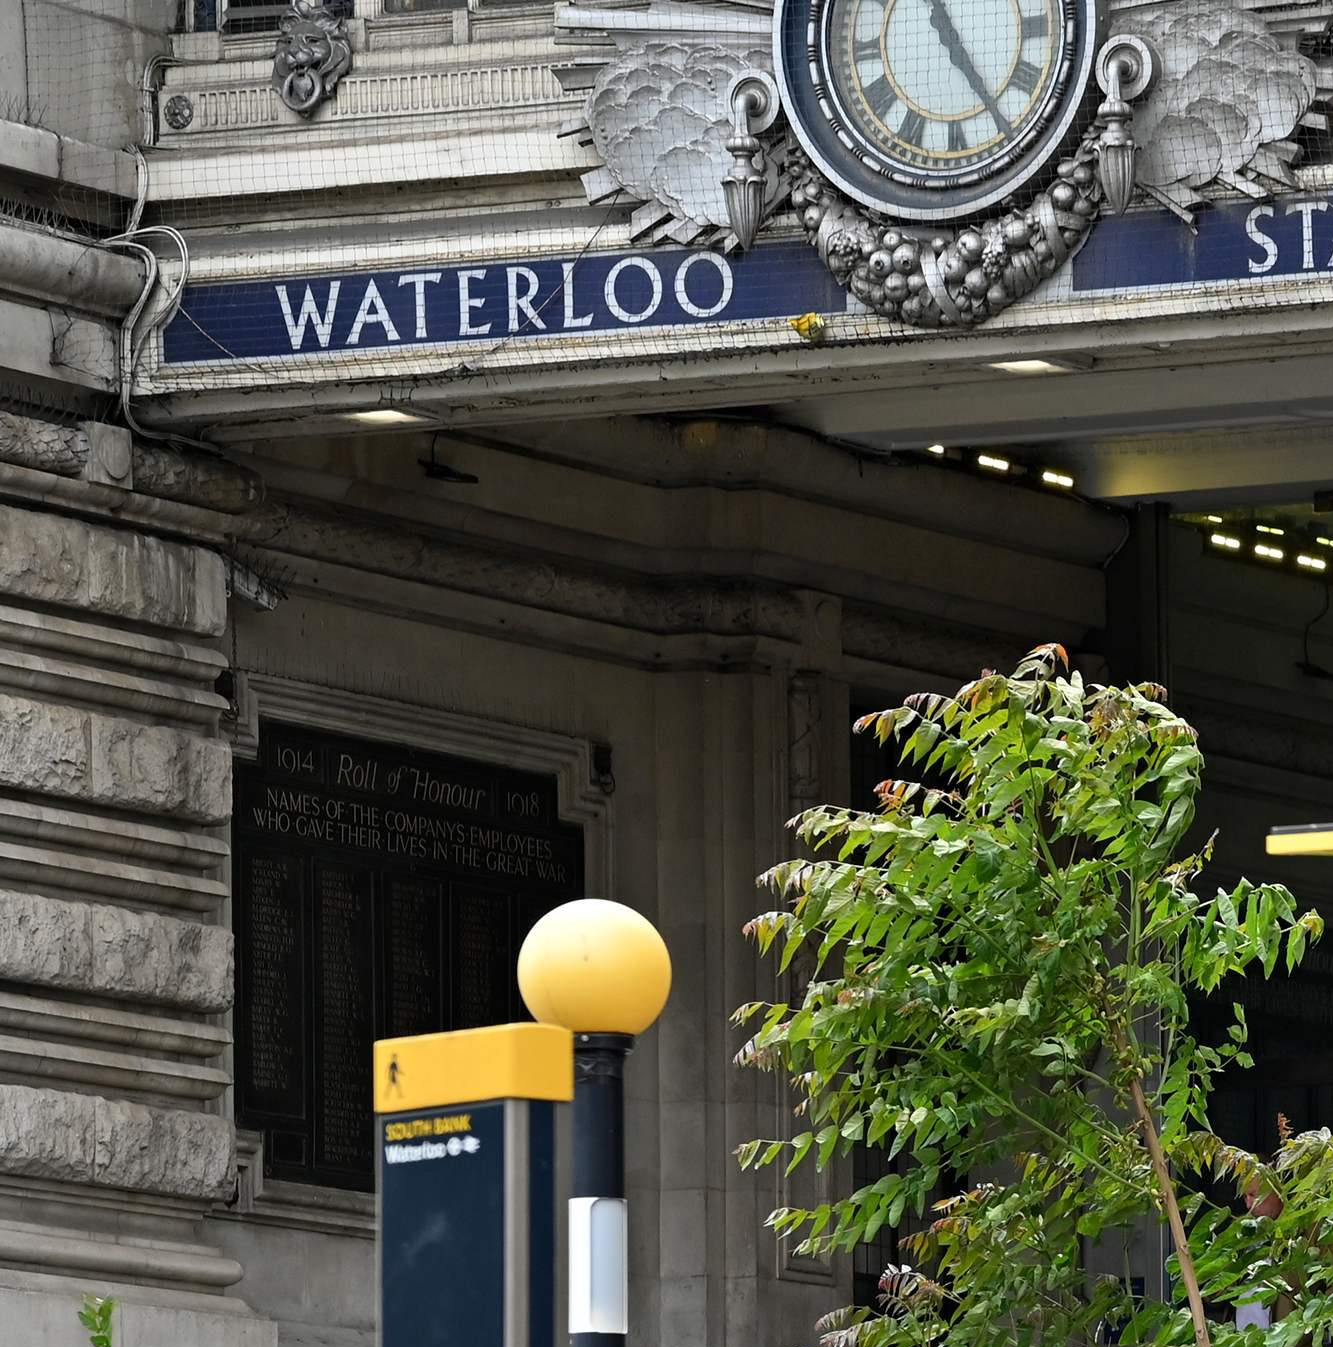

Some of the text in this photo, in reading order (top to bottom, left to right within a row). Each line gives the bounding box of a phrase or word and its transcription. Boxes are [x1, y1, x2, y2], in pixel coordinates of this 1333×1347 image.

[276, 252, 734, 350] WATERLOO
[276, 746, 541, 817] 1914 Roll of Honour 1918
[253, 807, 568, 885] WHO GAVE THEIR LIVES IN THE GREAT WAR
[266, 787, 321, 816] NAMES
[325, 799, 345, 820] OF
[350, 802, 380, 828] THE
[470, 826, 552, 860] EMPLOYEES
